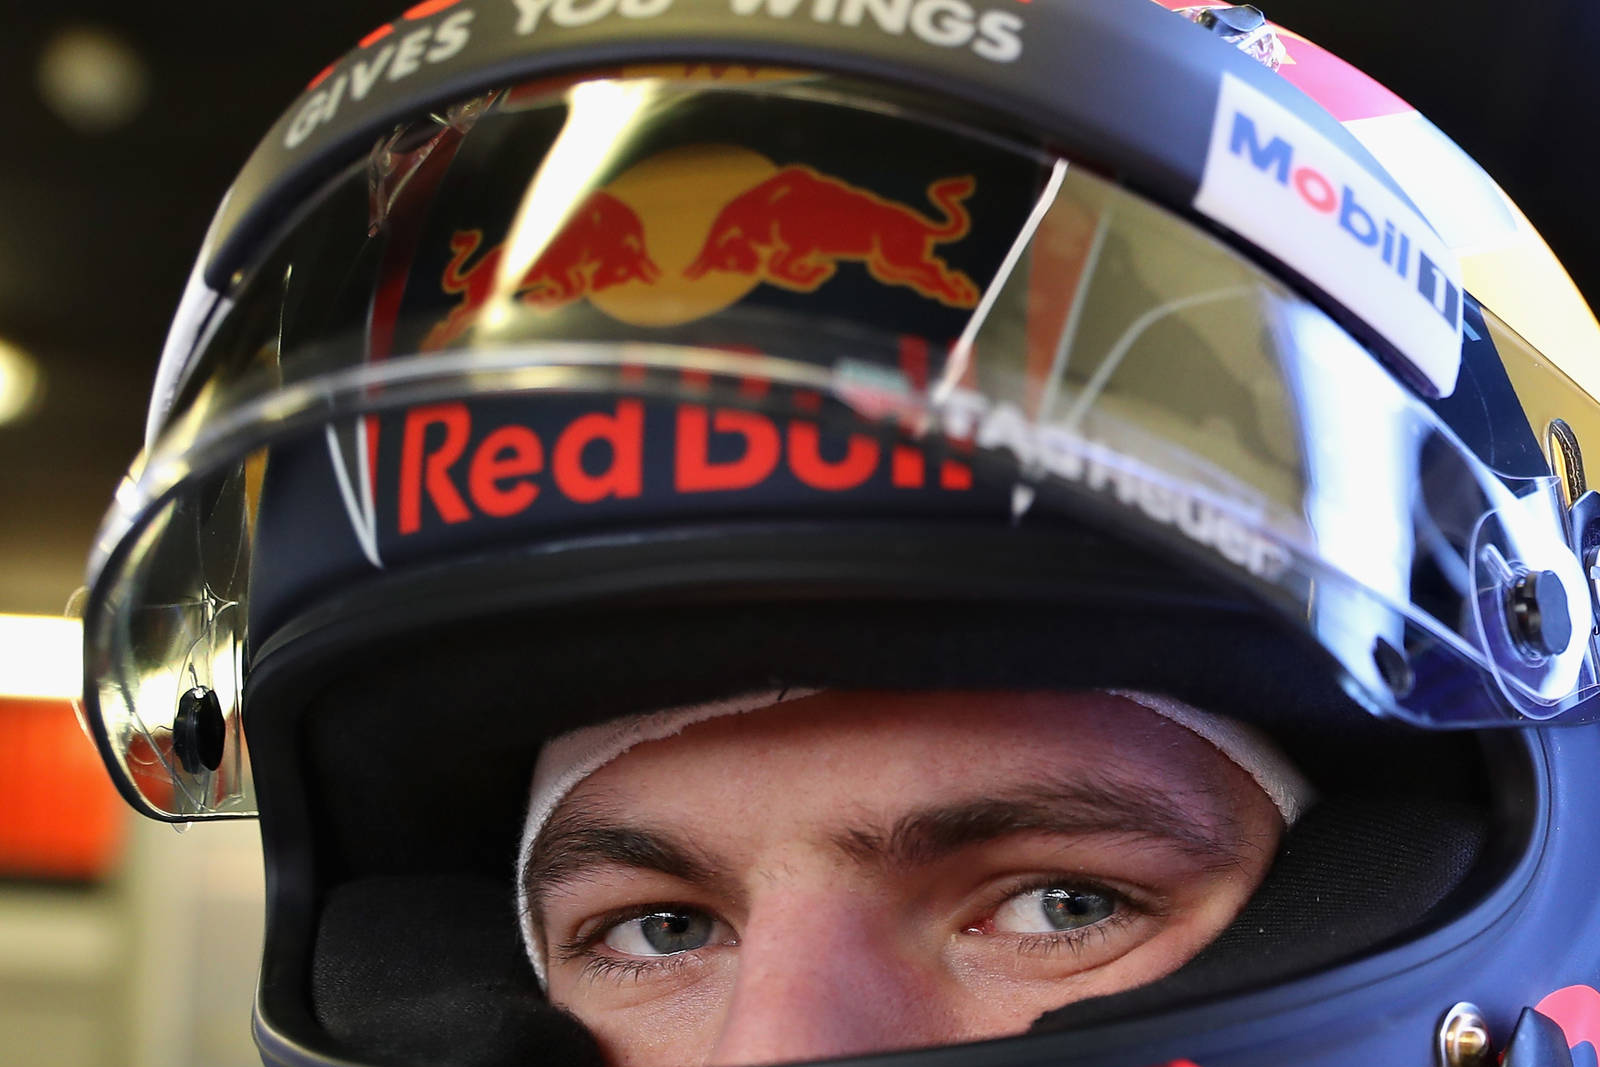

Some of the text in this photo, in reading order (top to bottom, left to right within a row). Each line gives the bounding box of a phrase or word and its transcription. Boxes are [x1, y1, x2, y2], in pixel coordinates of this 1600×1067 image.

[284, 9, 475, 150] GIVES
[1229, 110, 1410, 280] Mobil
[398, 360, 646, 536] Red
